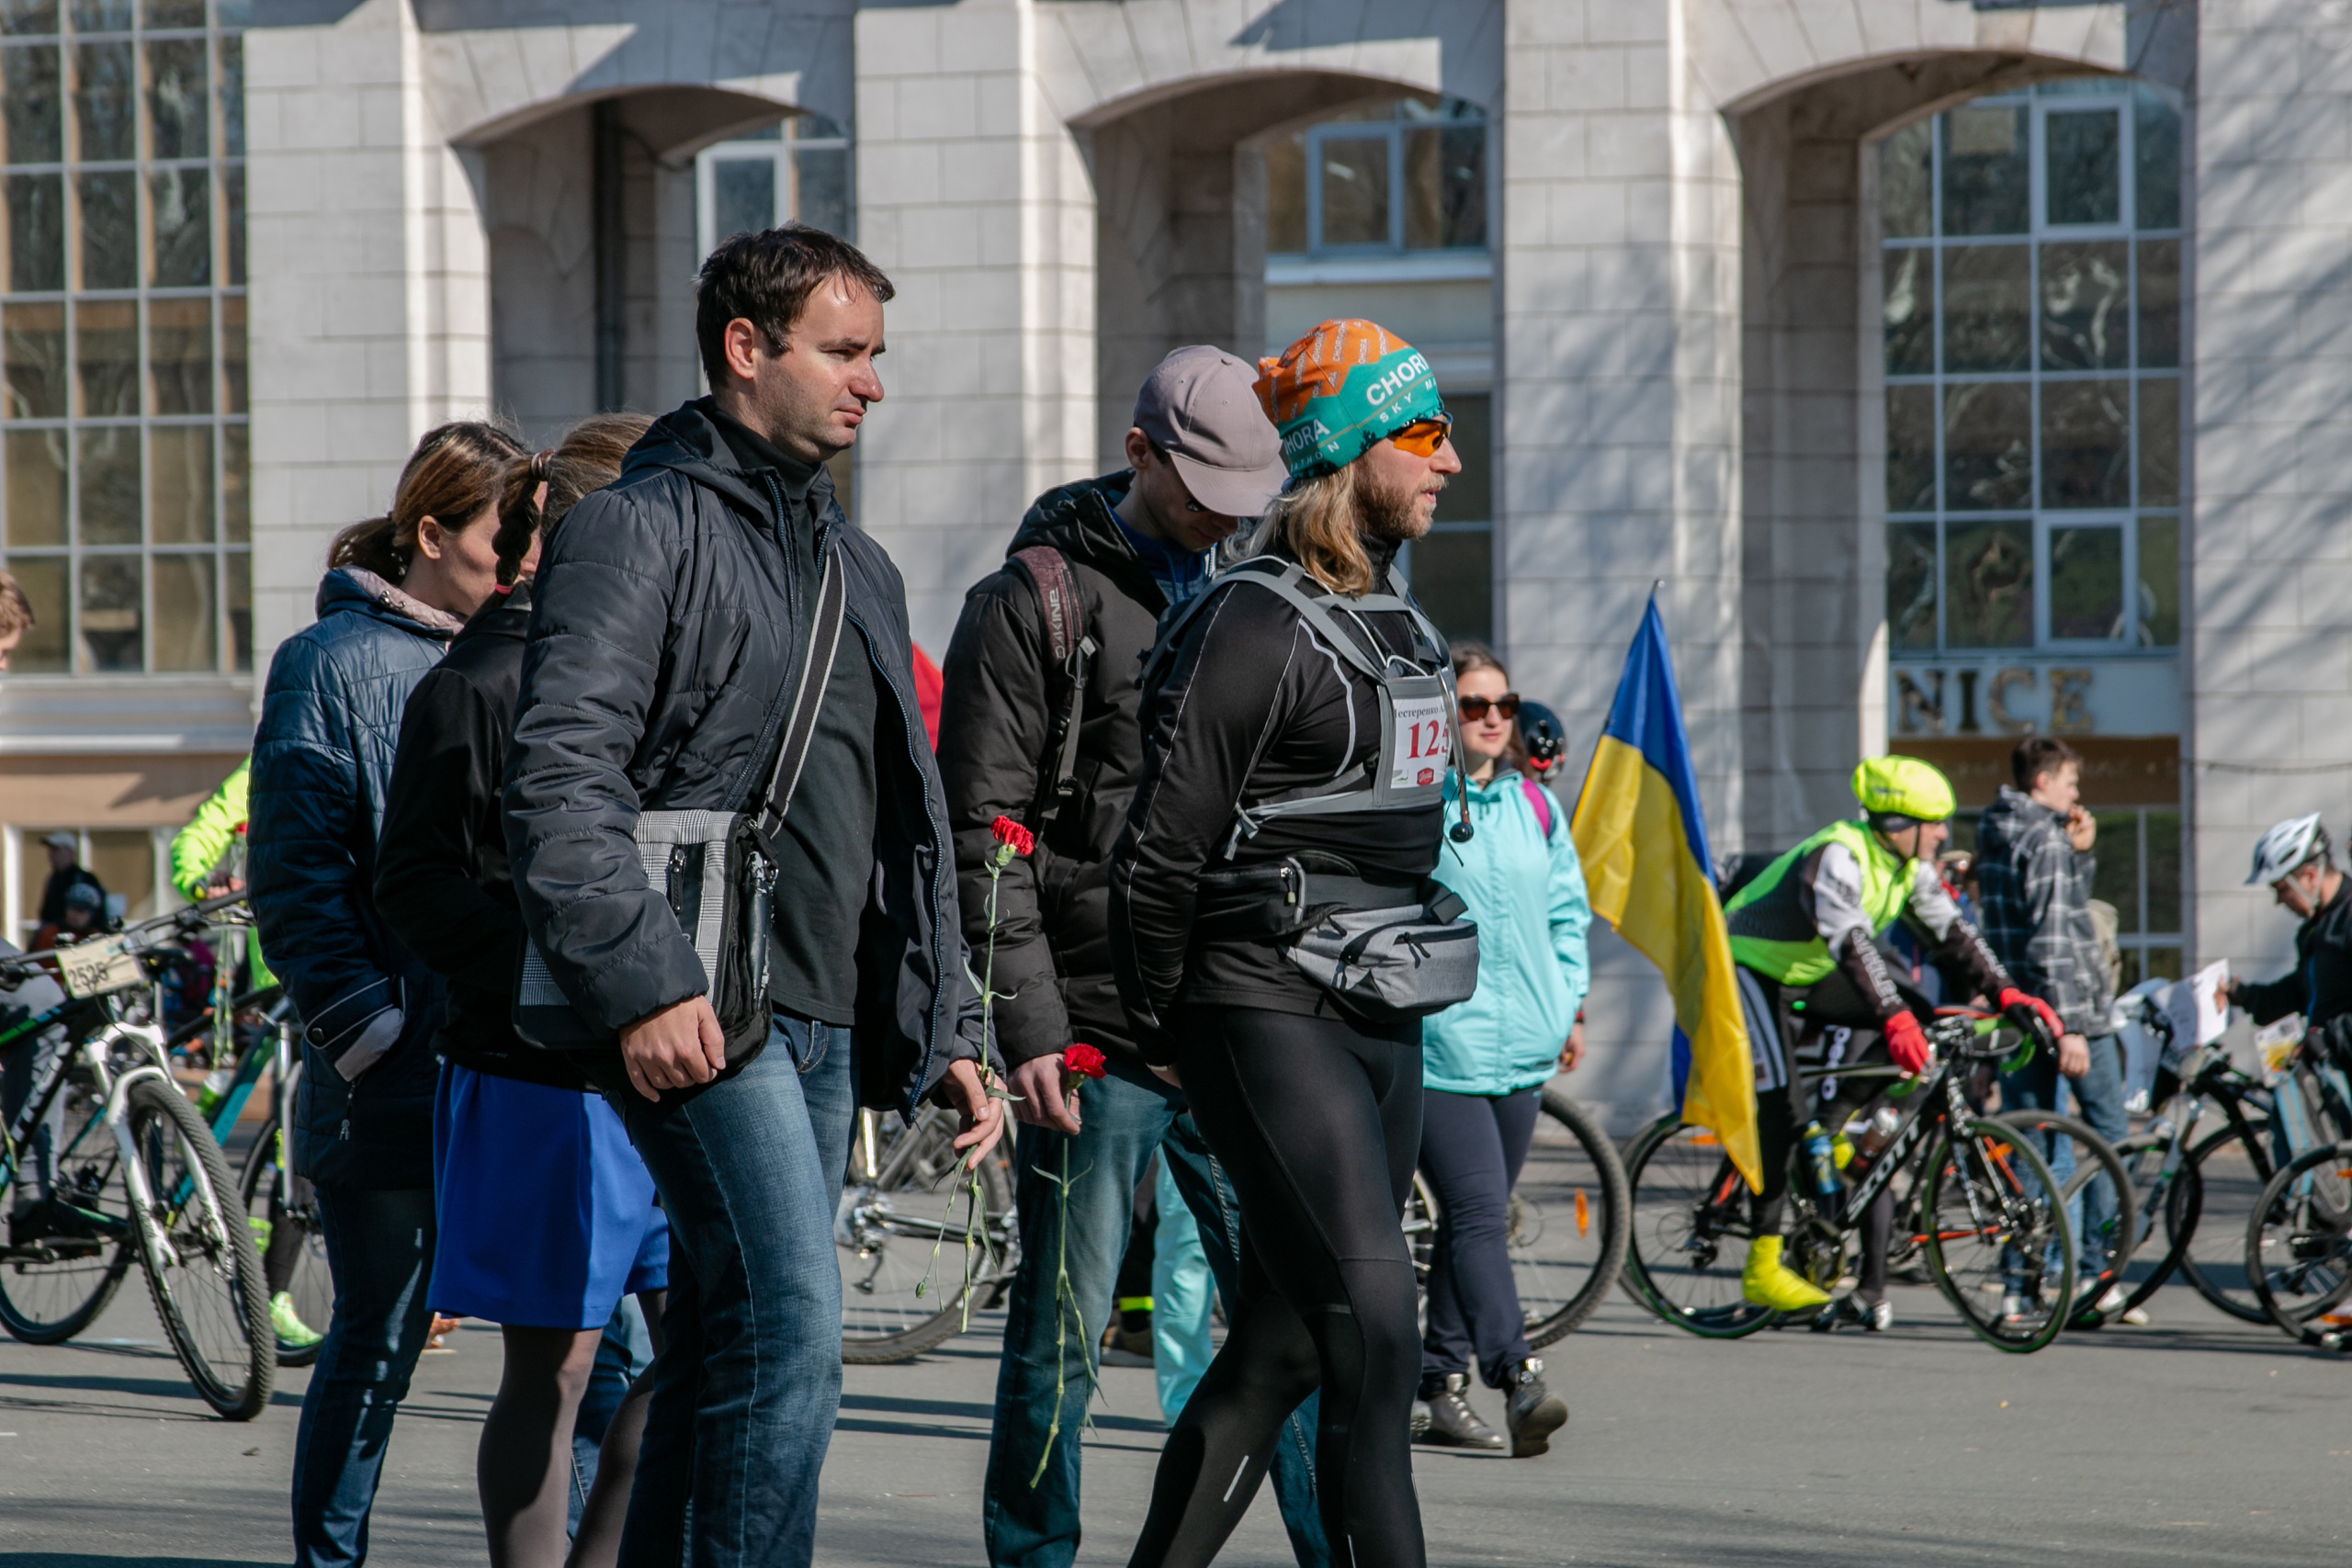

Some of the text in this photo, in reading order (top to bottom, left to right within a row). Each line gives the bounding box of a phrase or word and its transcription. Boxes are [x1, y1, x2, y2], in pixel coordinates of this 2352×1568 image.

[1379, 392, 1411, 423] SKY
[1049, 586, 1066, 660] DAKINE
[1895, 667, 2093, 734] NICE
[1847, 1114, 1921, 1224] SCOTT
